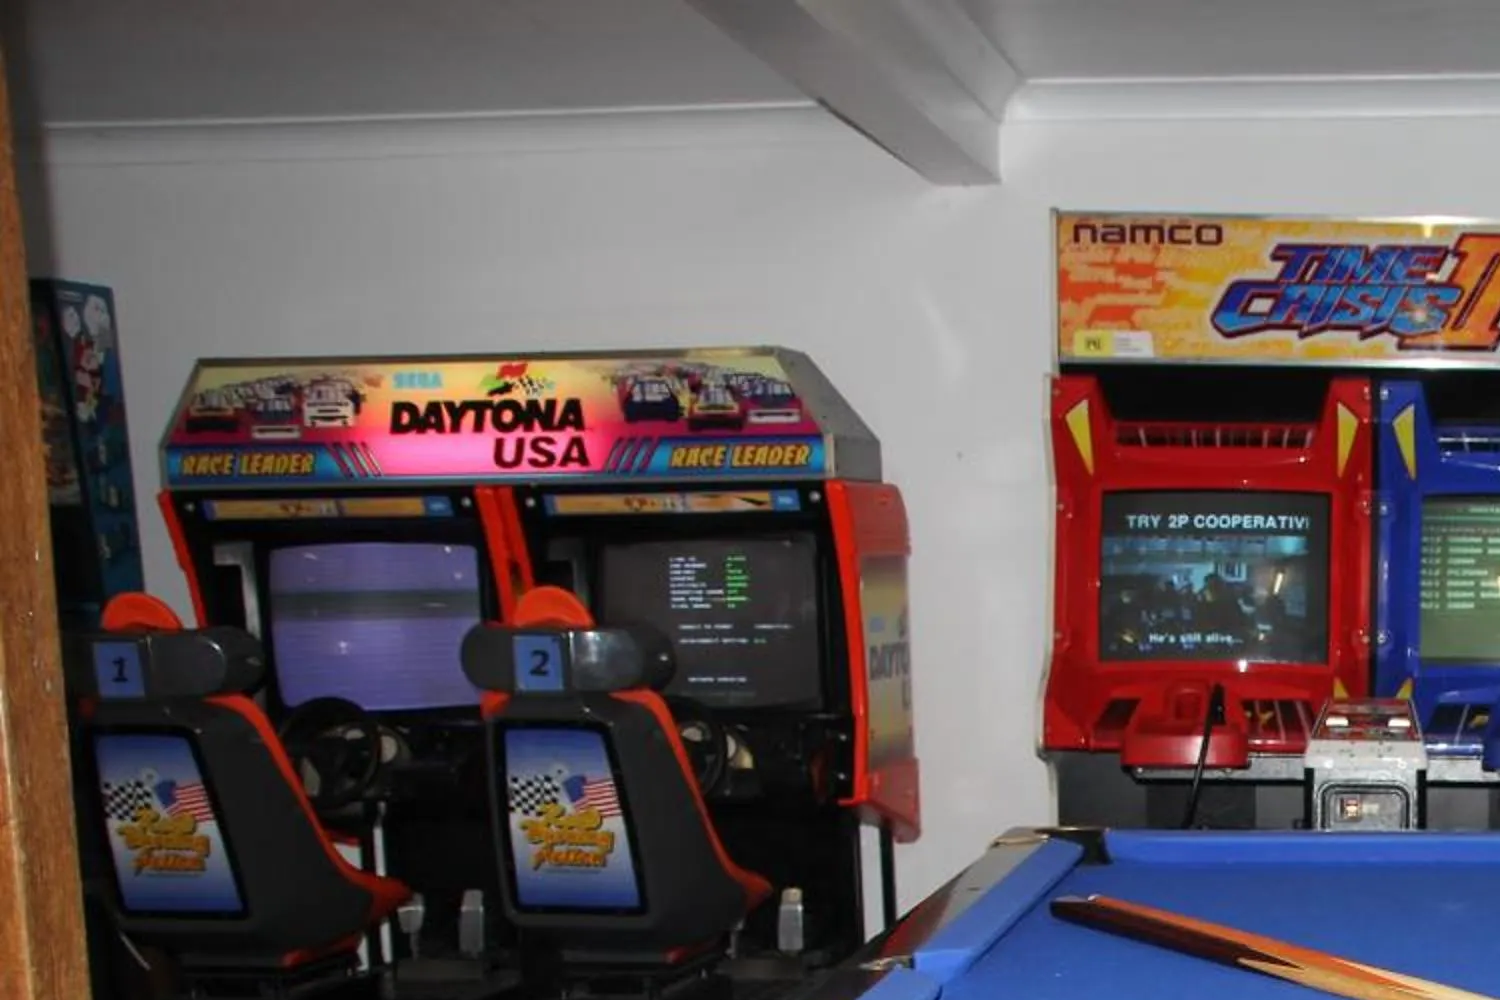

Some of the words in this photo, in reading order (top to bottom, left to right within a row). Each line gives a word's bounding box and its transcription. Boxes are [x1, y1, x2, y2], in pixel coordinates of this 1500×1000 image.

[1073, 224, 1223, 245] namco
[1271, 244, 1450, 284] TIME
[1211, 280, 1464, 340] CRISIS
[393, 373, 442, 389] SEGA
[389, 397, 586, 435] DAYTONA
[181, 452, 233, 476] RACE
[239, 452, 316, 475] LEADER
[493, 437, 589, 469] USA
[670, 446, 724, 469] RACE
[730, 444, 812, 468] LEADER
[1125, 514, 1162, 530] TRY
[1167, 514, 1190, 530] 2P
[111, 656, 129, 683] 1
[529, 650, 550, 676] 2
